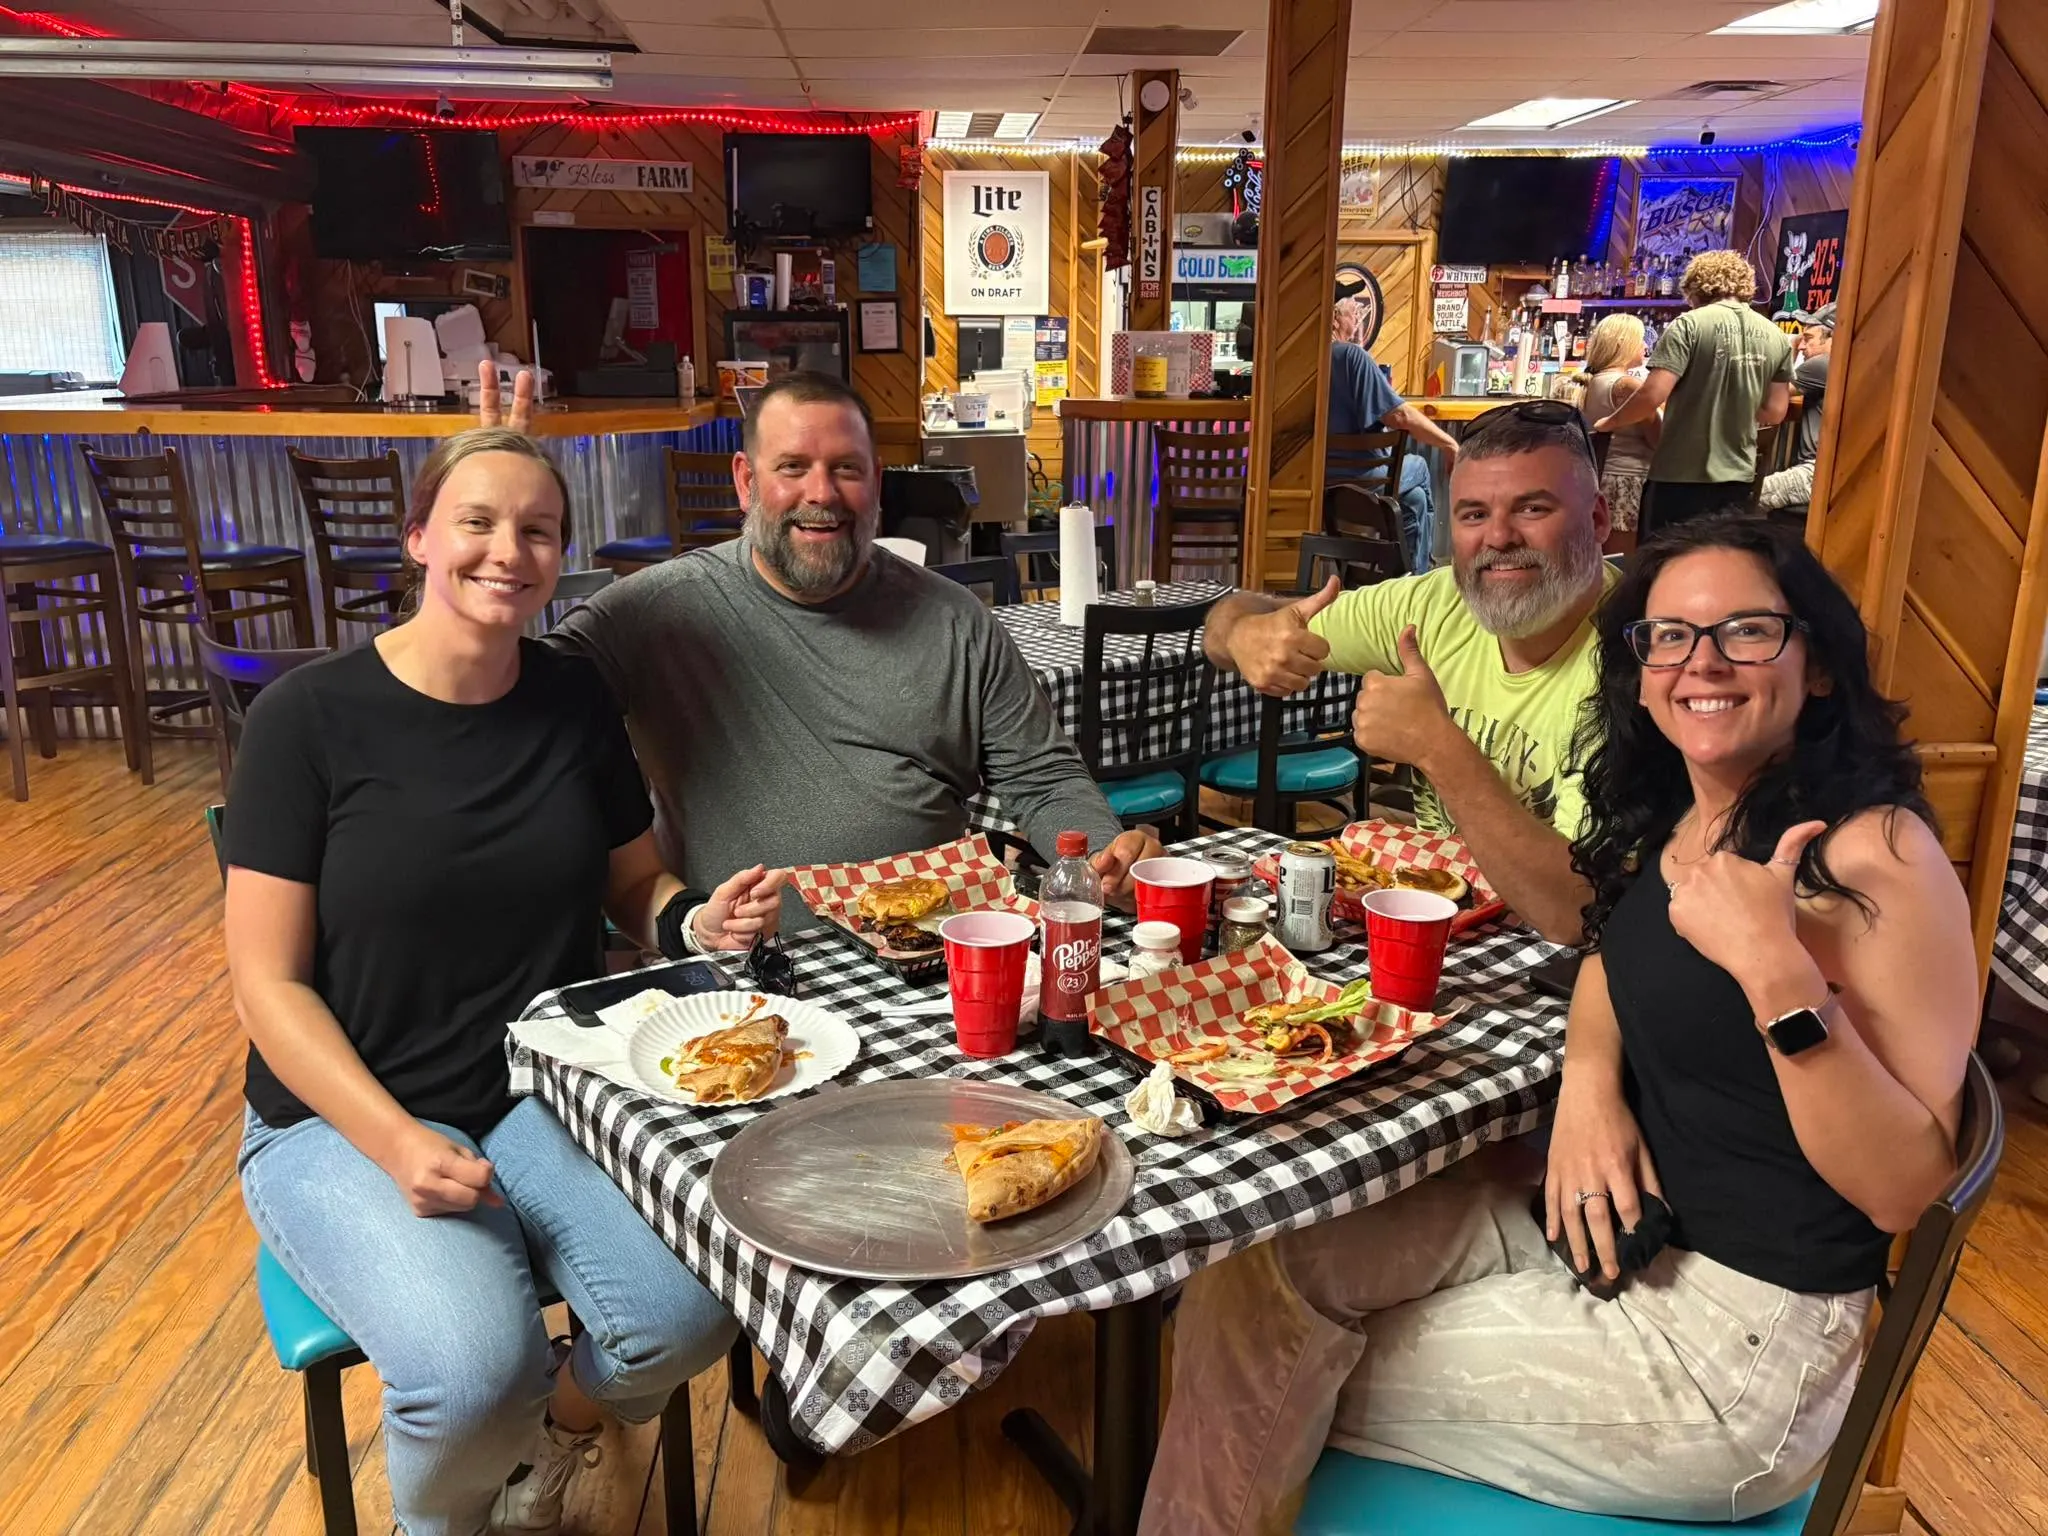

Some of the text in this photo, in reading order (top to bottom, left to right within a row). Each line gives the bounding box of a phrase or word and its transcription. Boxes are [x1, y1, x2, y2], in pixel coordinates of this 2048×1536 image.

[568, 163, 615, 186] Bless
[636, 165, 688, 189] FARM
[971, 185, 1022, 218] Lite
[1645, 186, 1729, 233] BUSCH
[1144, 189, 1158, 278] CABINS
[1178, 257, 1215, 278] COLD
[1446, 271, 1485, 281] WHINING
[971, 288, 1022, 297] ON DRAFT
[1141, 282, 1159, 291] FOR
[1141, 290, 1159, 298] RENT
[1436, 303, 1461, 311] BRAND
[1436, 311, 1454, 319] YOUR
[1435, 319, 1461, 327] CATTLE
[1073, 939, 1092, 956] Dr
[1054, 942, 1099, 971] Pepper
[1066, 977, 1079, 988] 23
